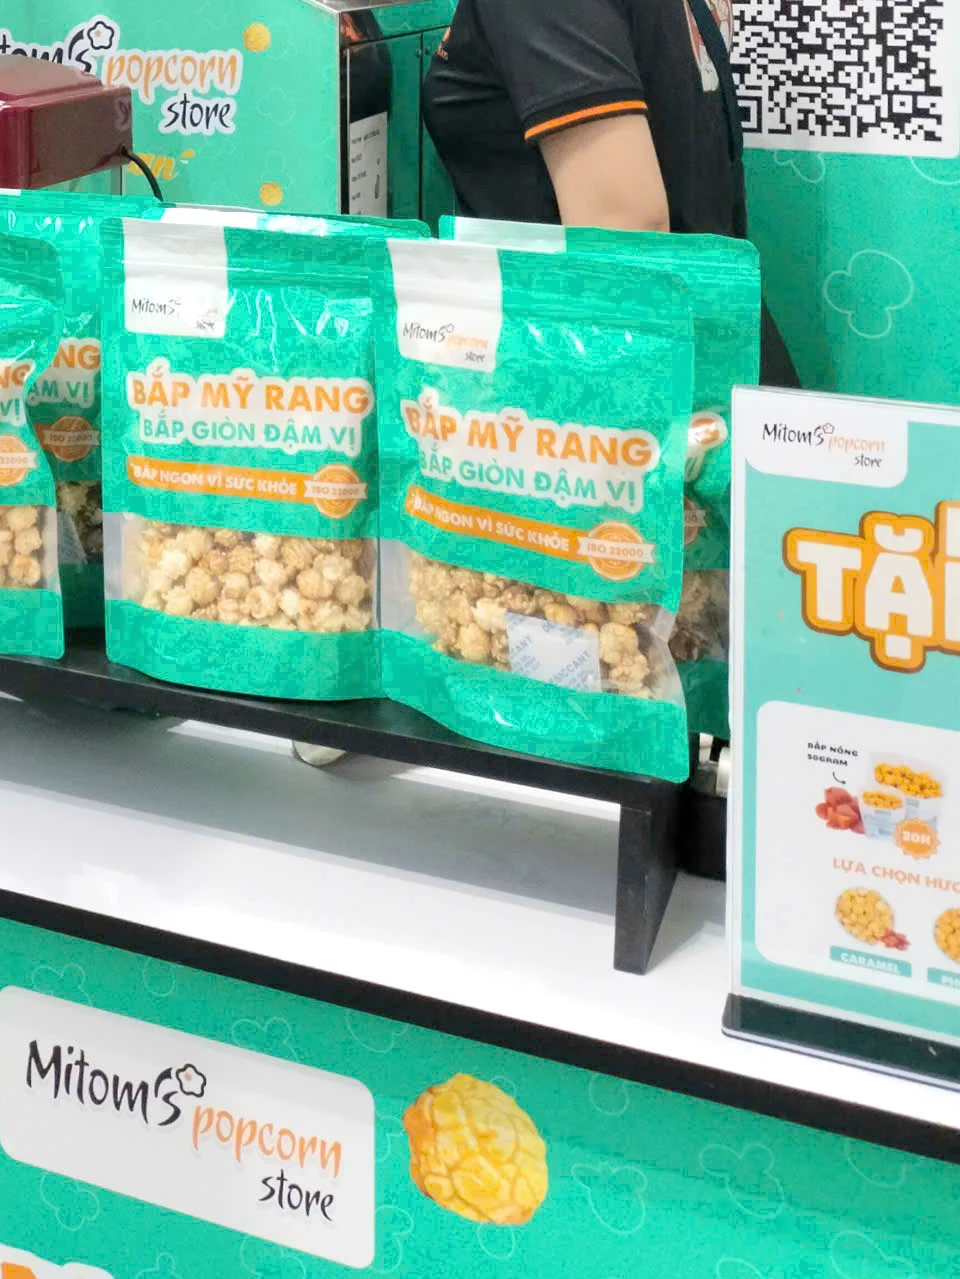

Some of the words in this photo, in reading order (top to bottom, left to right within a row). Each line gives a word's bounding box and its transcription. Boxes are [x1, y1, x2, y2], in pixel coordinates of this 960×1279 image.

[106, 54, 237, 98] popcorn
[164, 93, 231, 129] store
[132, 365, 190, 407] BẮP
[200, 376, 254, 409] MỸ
[265, 384, 369, 414] RANG
[143, 410, 185, 438] BẮP
[191, 416, 255, 441] GIÒN
[264, 418, 321, 449] ĐẬM
[330, 426, 357, 453] VỊ
[405, 396, 456, 442] BẮP
[467, 415, 524, 453] MỸ
[536, 427, 652, 467] RANG
[827, 434, 885, 455] popcorn
[160, 470, 204, 486] NGON
[459, 457, 524, 489] GIÒN
[534, 467, 597, 501] ĐẬM
[606, 480, 636, 507] VỊ
[853, 453, 883, 468] store
[435, 508, 473, 528] NGON
[587, 543, 606, 554] ISO
[790, 504, 960, 666] TẶ
[192, 1103, 343, 1178] popcorn
[259, 1168, 334, 1221] store
